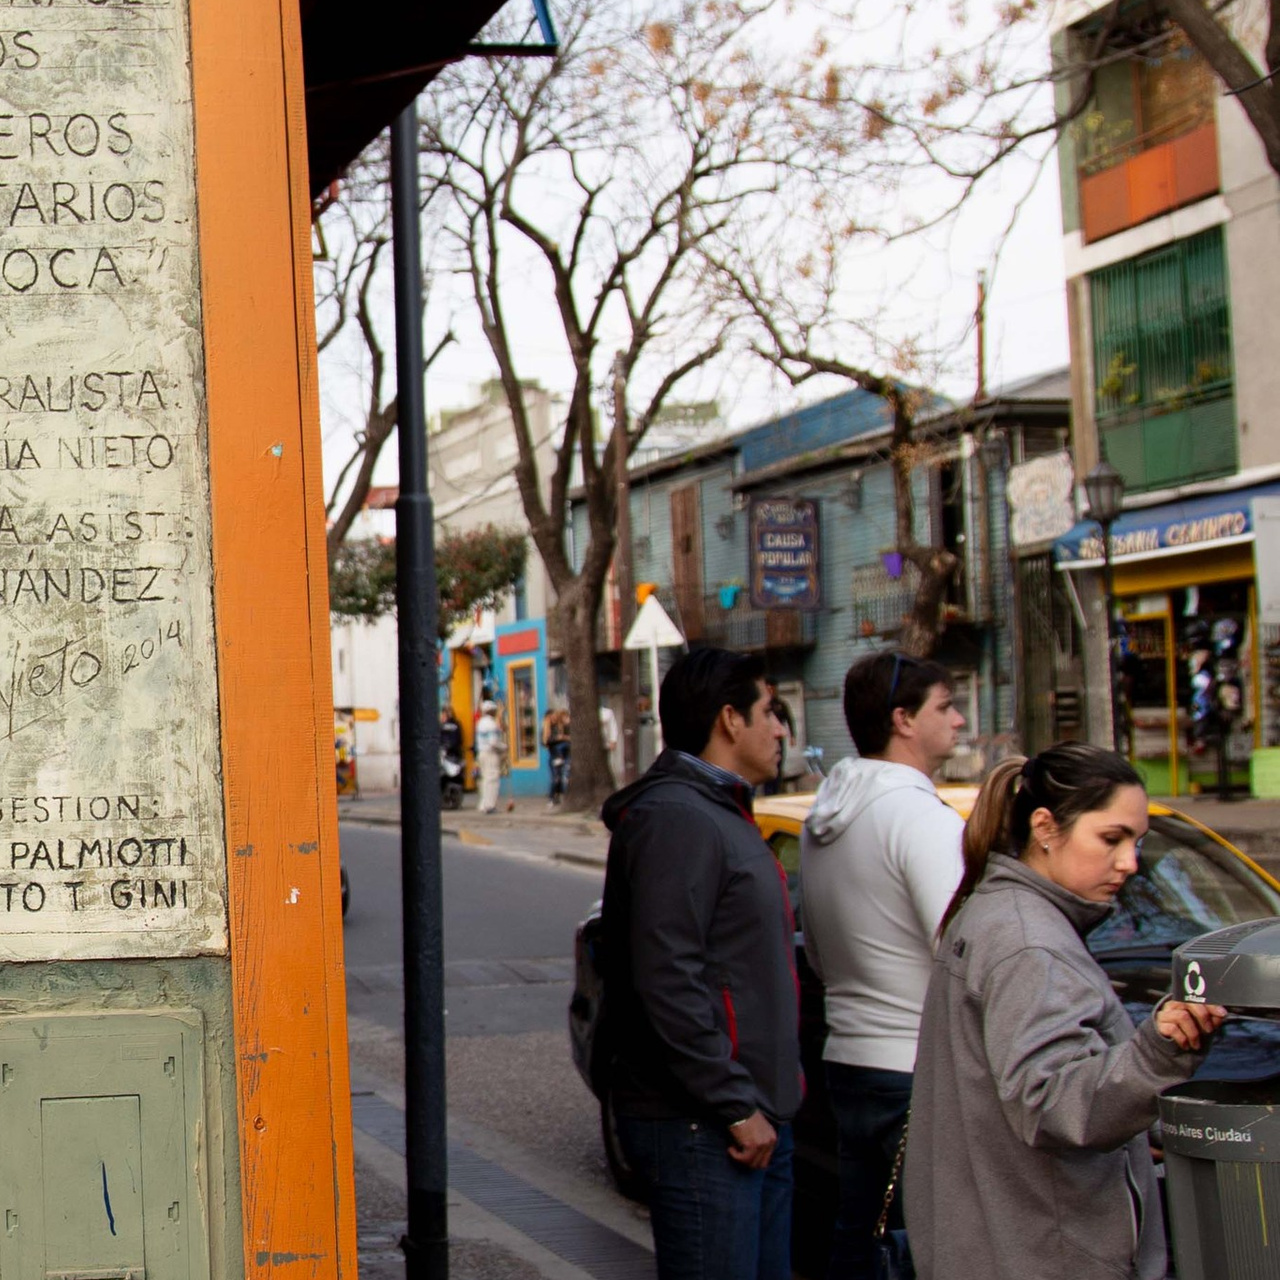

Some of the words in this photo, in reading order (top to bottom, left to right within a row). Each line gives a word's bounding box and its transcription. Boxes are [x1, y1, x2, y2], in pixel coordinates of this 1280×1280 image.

[58, 434, 174, 473] NIETO
[765, 532, 806, 549] CAUSA
[761, 550, 813, 567] POPULAR
[122, 619, 183, 674] 2014
[10, 837, 189, 871] PALMIOTTI
[63, 880, 86, 912] T
[109, 878, 189, 911] GINI
[1179, 1122, 1203, 1140] Aires
